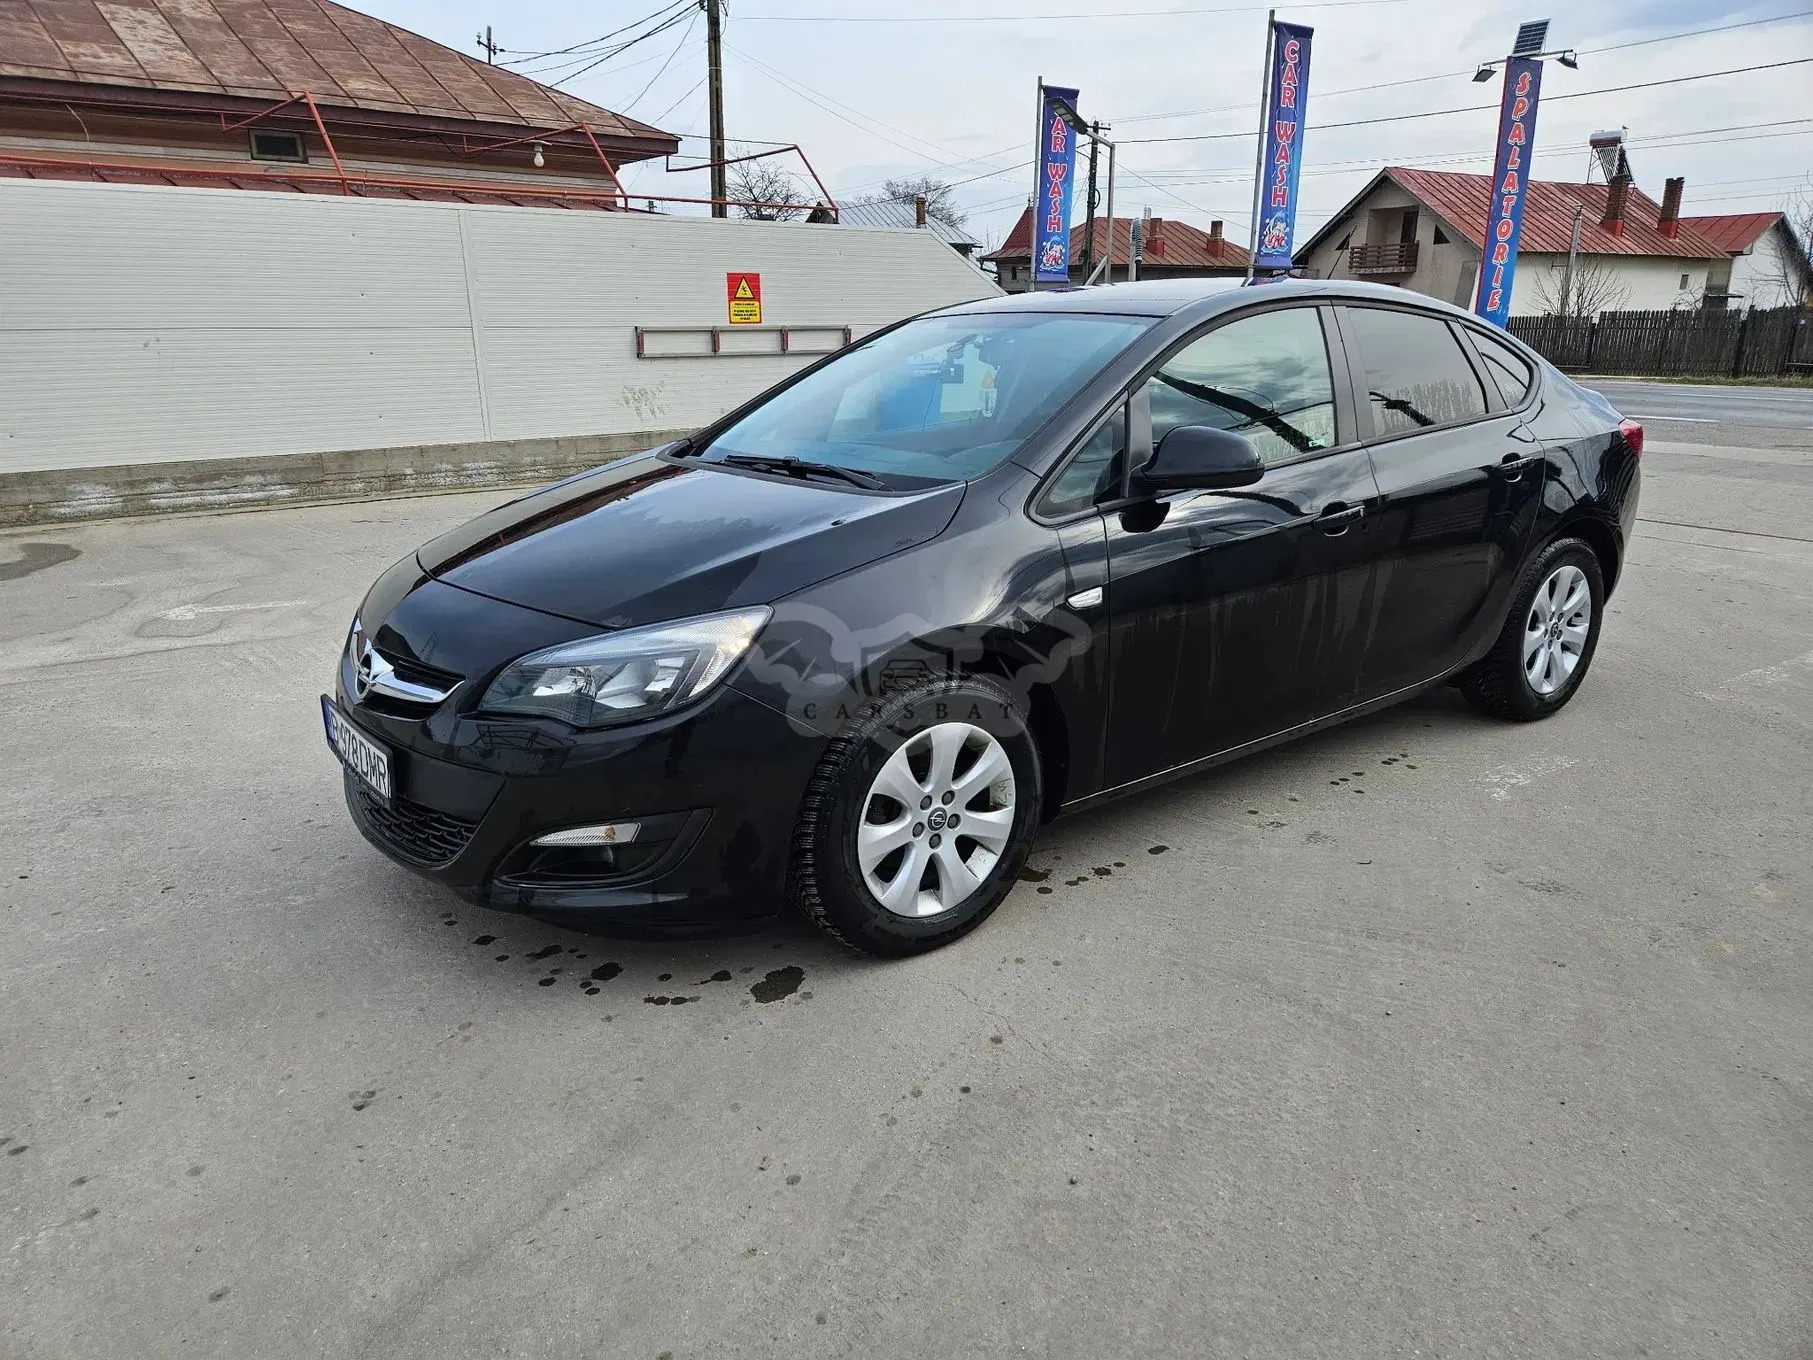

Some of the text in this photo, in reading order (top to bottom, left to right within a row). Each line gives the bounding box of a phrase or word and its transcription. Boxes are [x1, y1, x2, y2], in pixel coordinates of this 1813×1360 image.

[1047, 116, 1067, 233] AR WASH
[1271, 39, 1300, 208] CAR WASH
[1486, 71, 1532, 312] SPALATORIE
